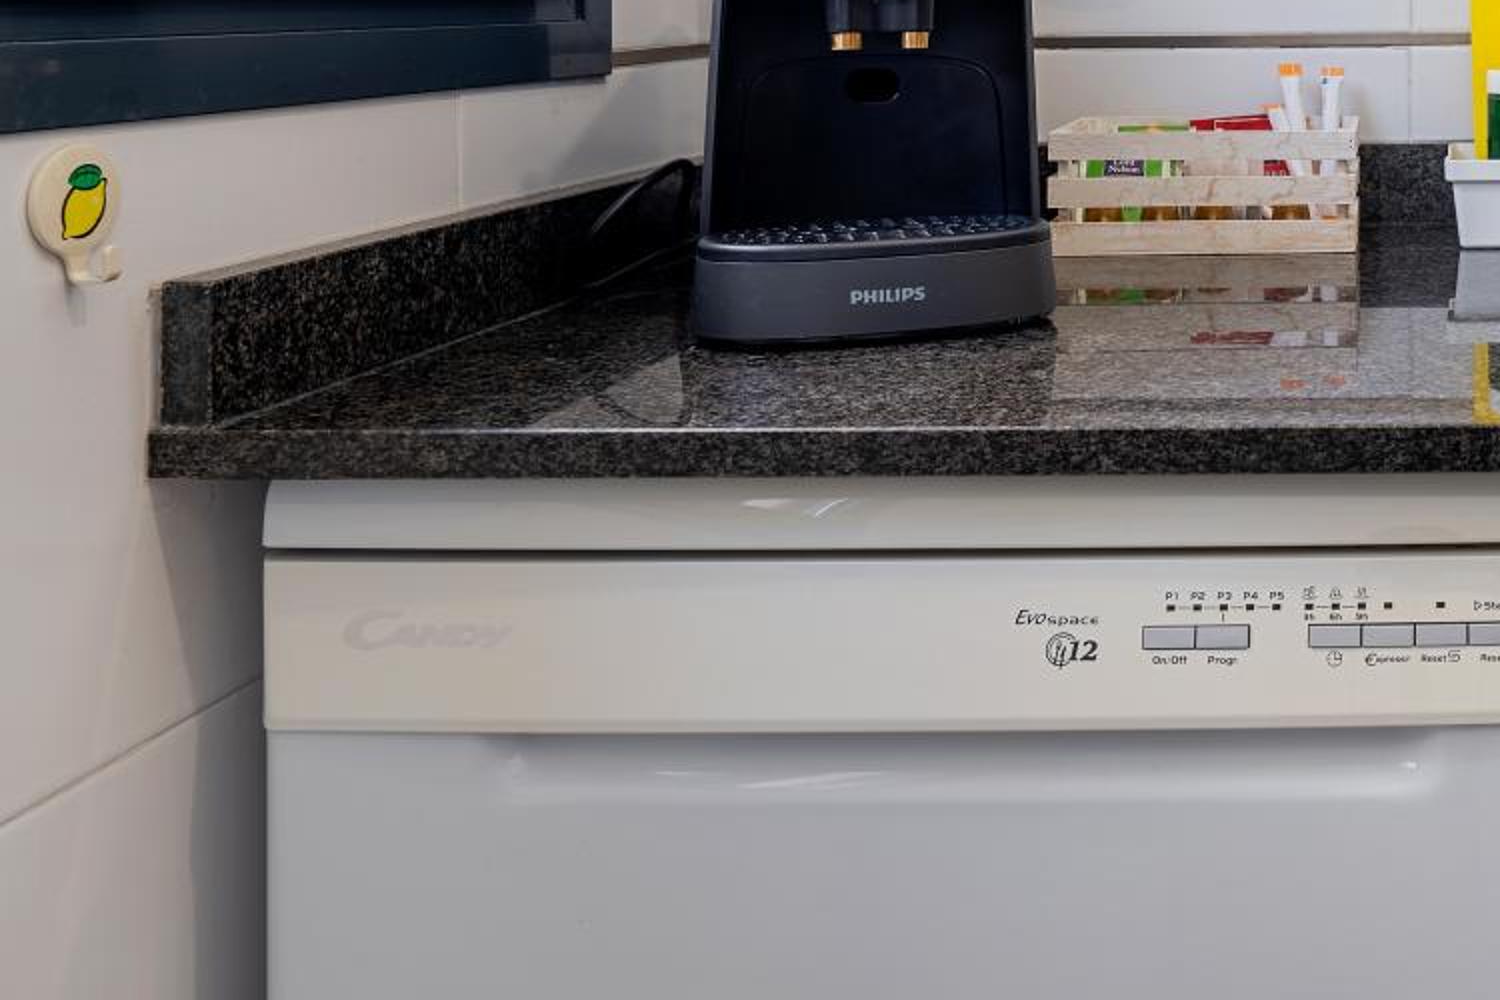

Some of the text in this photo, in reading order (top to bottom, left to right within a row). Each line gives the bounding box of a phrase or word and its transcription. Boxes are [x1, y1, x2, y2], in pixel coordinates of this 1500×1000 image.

[849, 285, 926, 305] PHILIPS
[1165, 591, 1179, 601] P1
[1190, 591, 1206, 601] P2
[1243, 591, 1259, 600] P4
[1269, 591, 1285, 600] P5
[1068, 639, 1099, 661] 12
